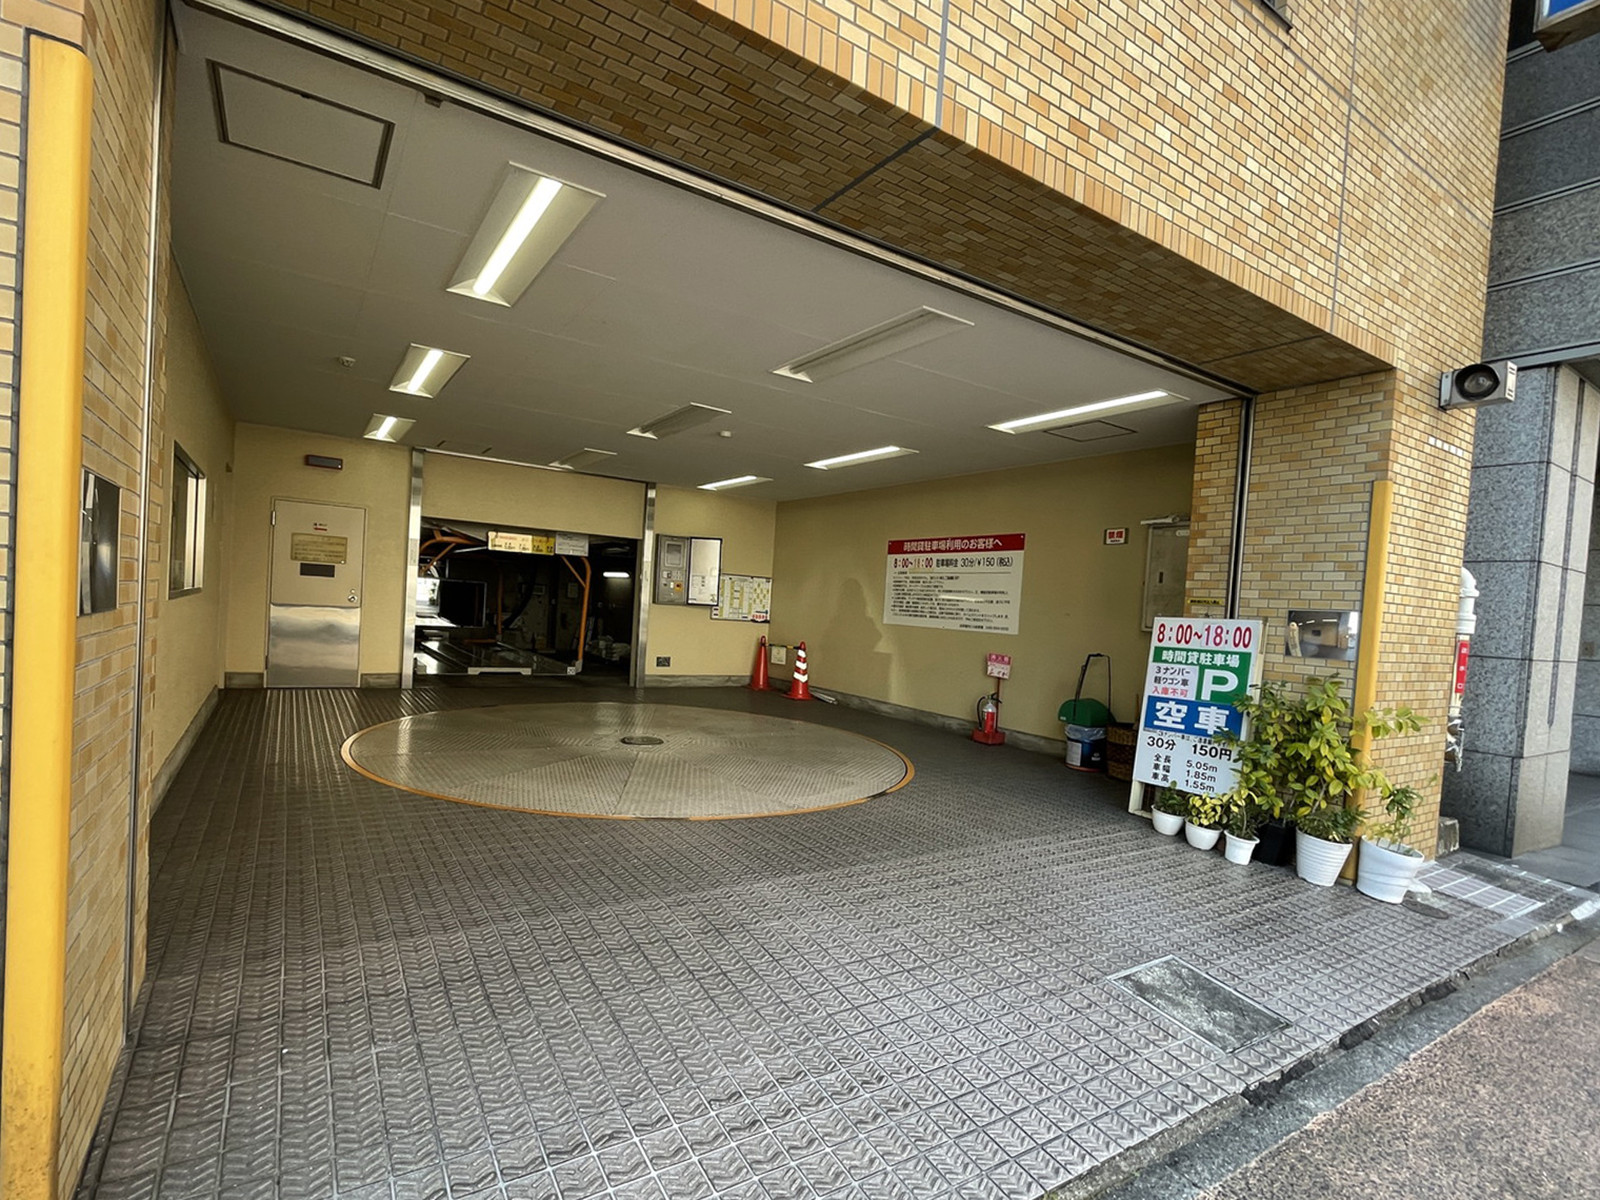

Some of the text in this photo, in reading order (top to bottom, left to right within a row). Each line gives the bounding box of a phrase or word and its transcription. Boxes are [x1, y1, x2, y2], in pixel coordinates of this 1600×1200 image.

[903, 538, 1003, 551] 時間貸駐車場利用のお客様へ
[1161, 650, 1240, 668] 時間貸駐車場
[1154, 676, 1189, 687] 軽ワゴン車
[1201, 668, 1238, 700] P
[1152, 686, 1188, 697] 入庫不可
[1153, 700, 1230, 735] 空車
[1147, 736, 1232, 761] 30分 150円
[1186, 760, 1218, 773] 5.05m
[1186, 770, 1217, 782] 1.85m
[1185, 779, 1215, 792] 1.55m
